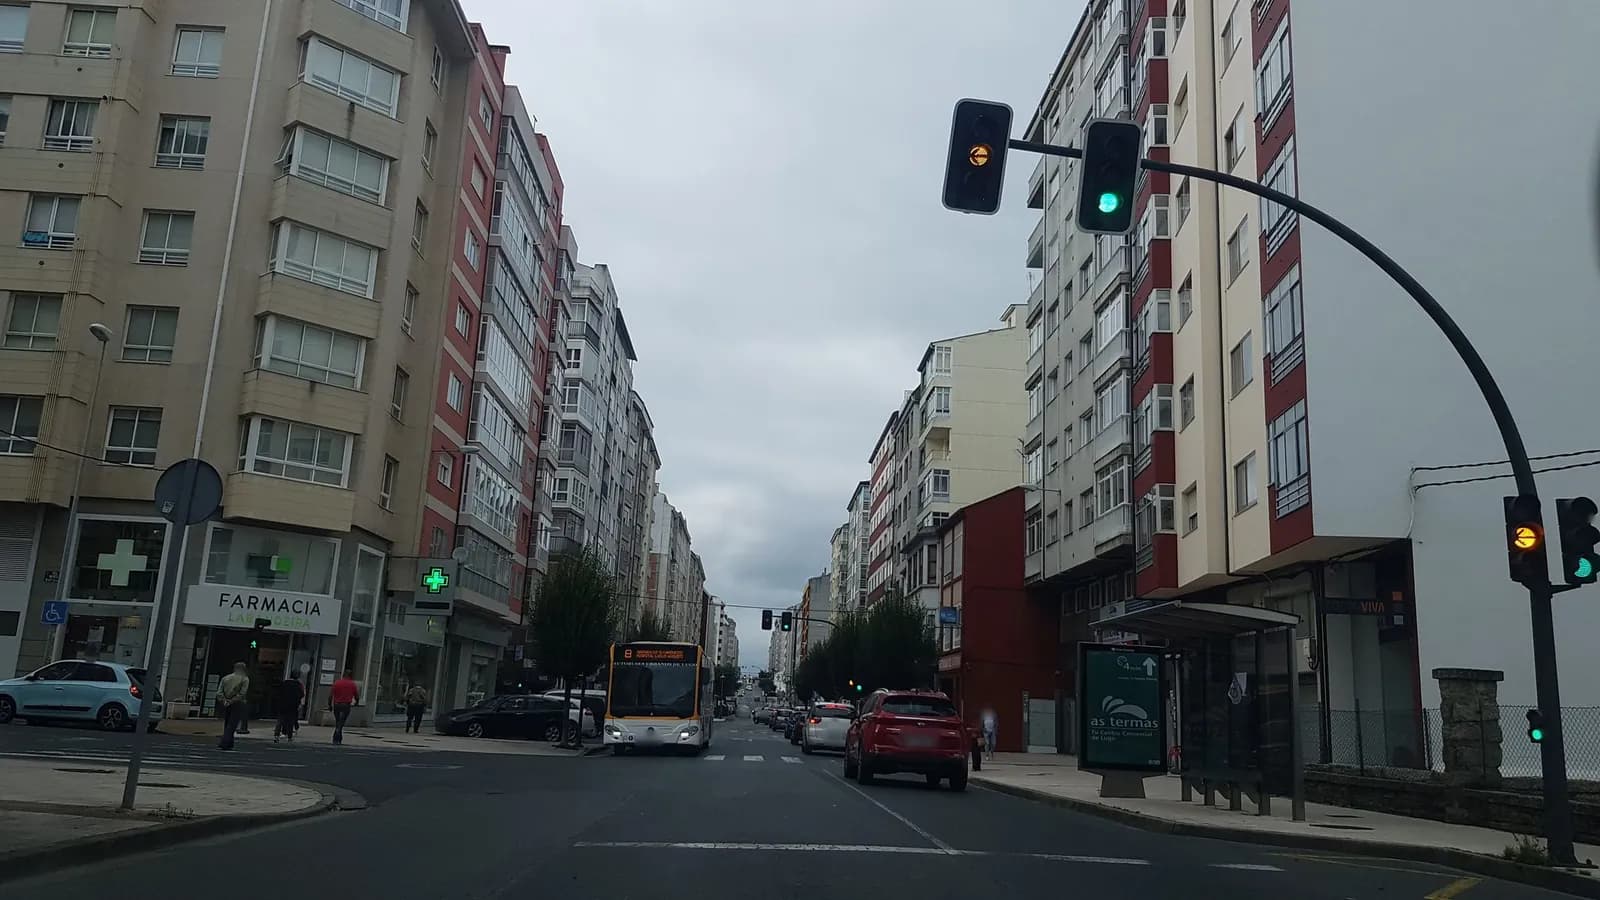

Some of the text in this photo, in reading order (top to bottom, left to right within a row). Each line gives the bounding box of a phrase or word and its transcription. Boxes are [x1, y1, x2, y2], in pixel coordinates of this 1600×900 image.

[219, 593, 321, 616] FARMACIA
[1360, 601, 1384, 613] VIVA
[1090, 717, 1159, 728] as termas
